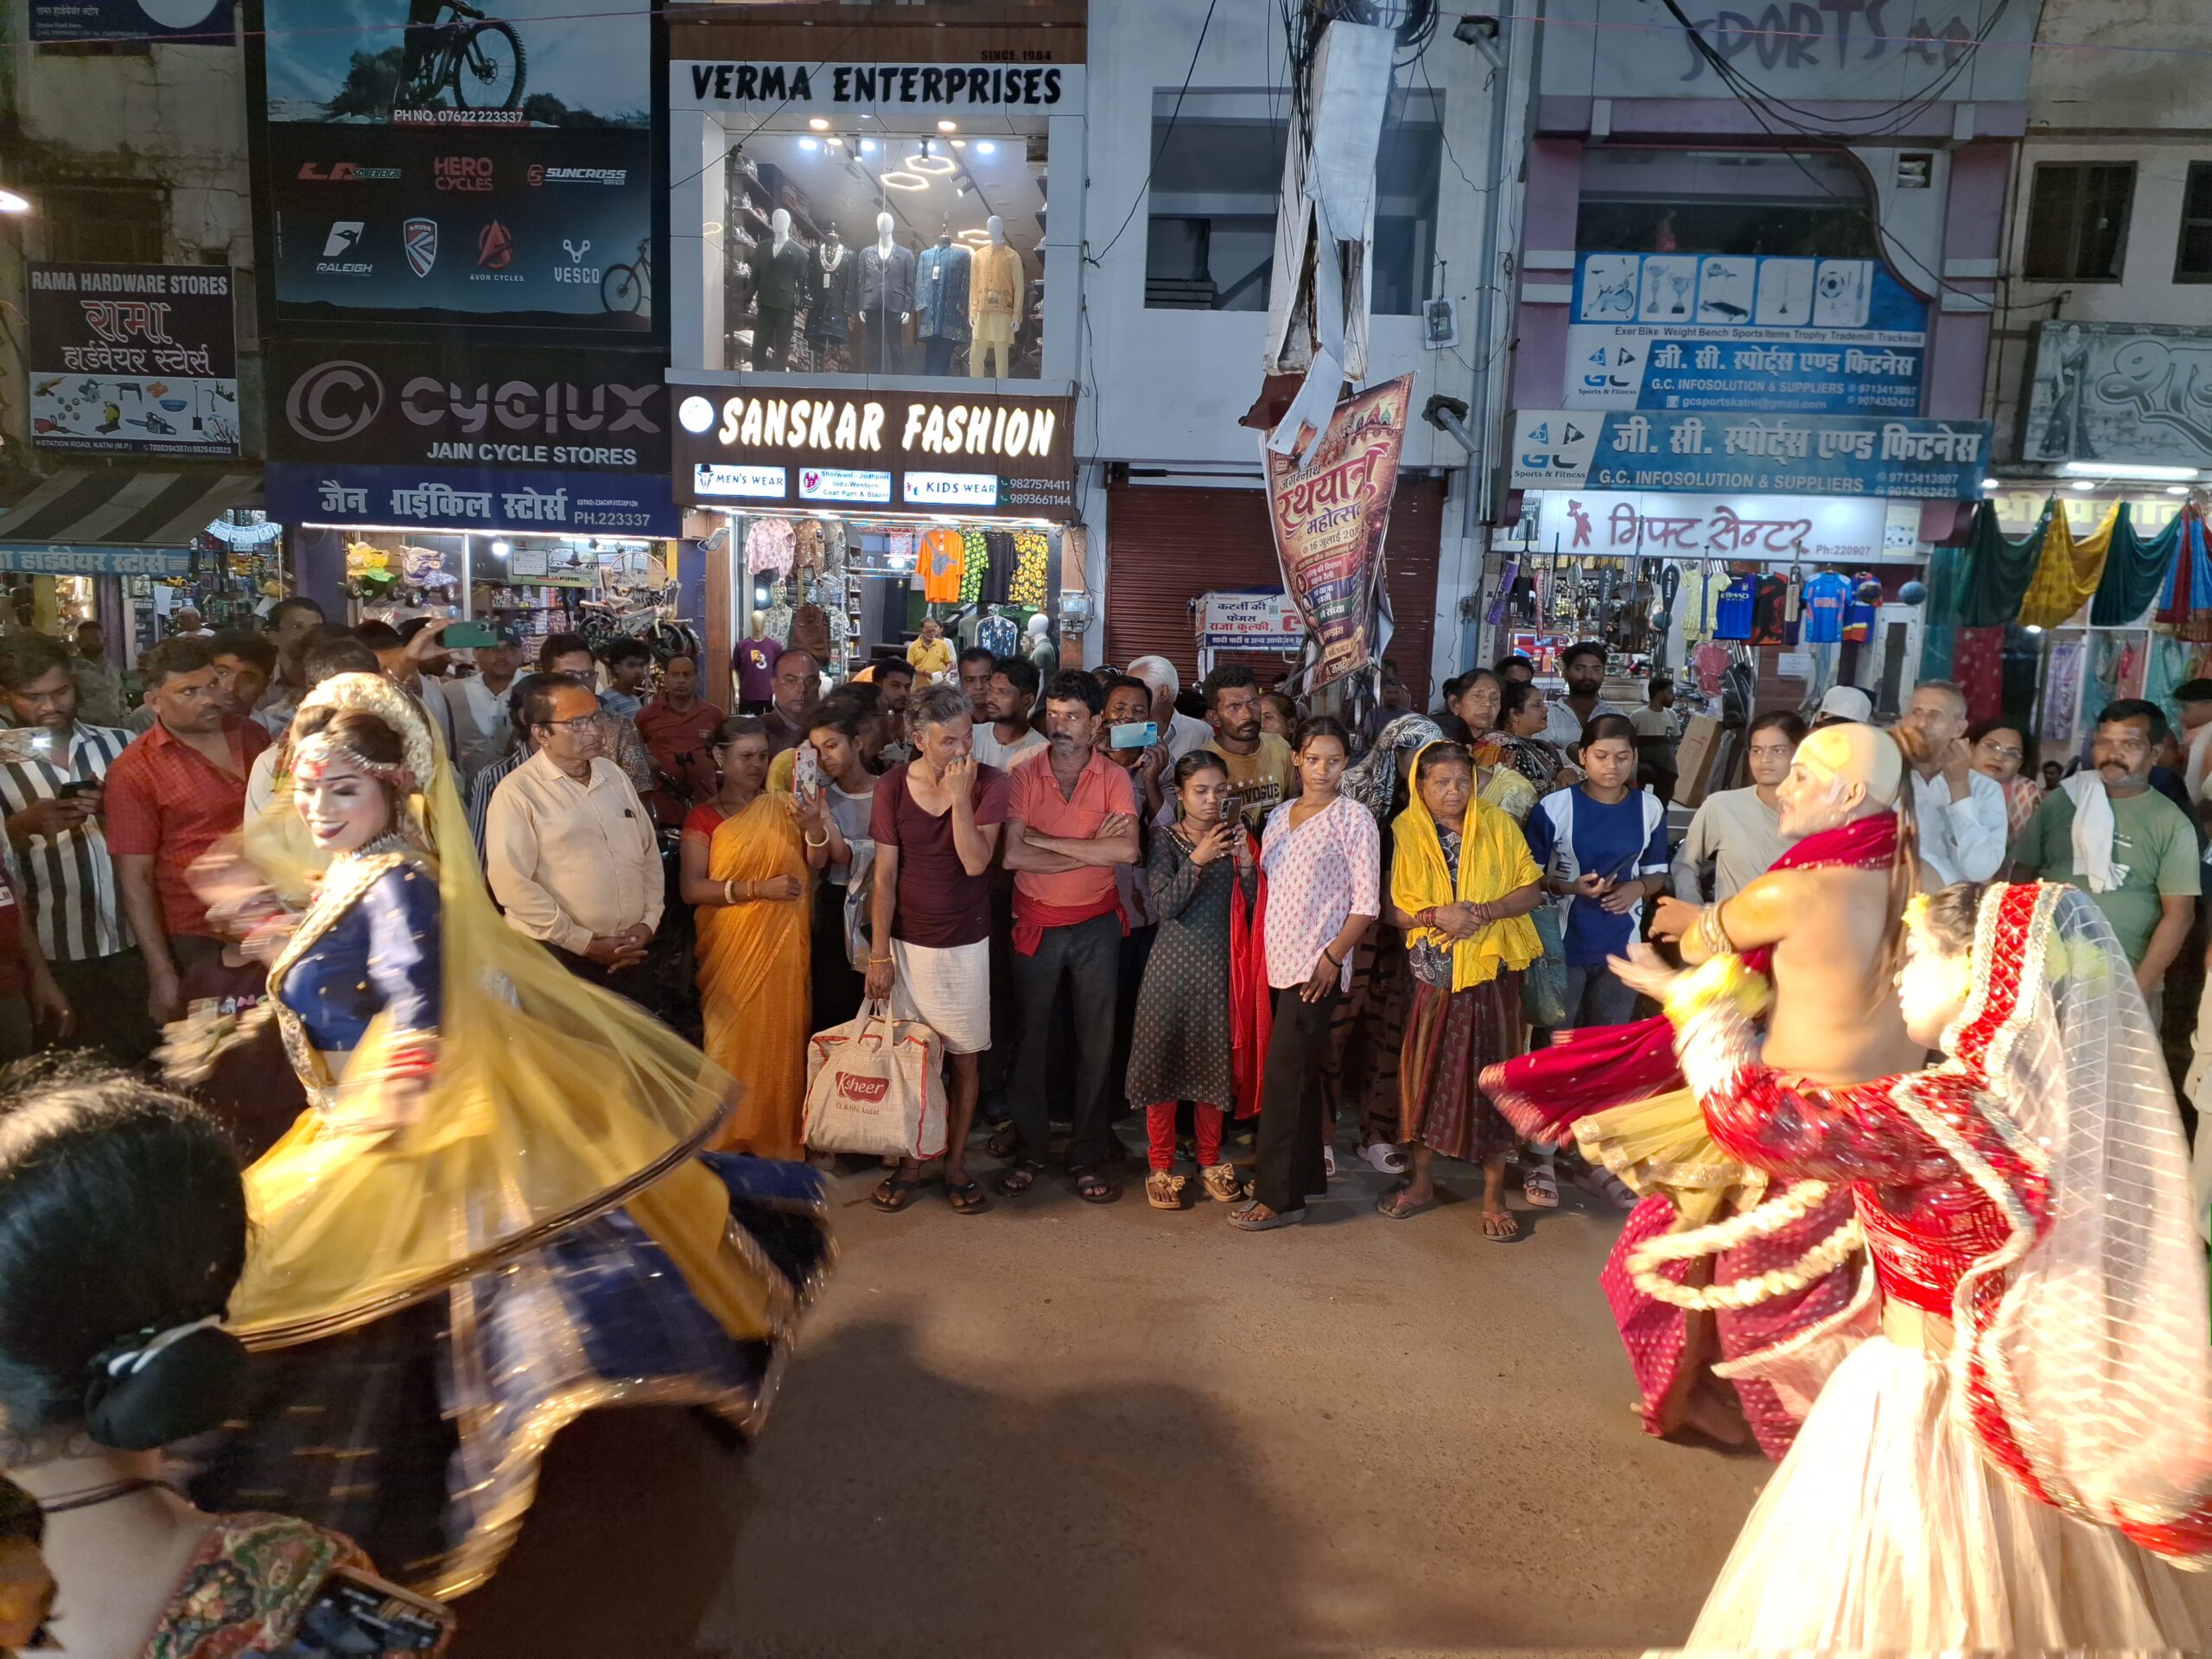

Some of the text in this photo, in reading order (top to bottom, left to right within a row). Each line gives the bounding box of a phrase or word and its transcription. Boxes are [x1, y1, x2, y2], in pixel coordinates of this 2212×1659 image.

[1681, 0, 1888, 81] SPORTS
[691, 64, 1061, 105] VERMA ENTERPRISES
[438, 110, 476, 122] 07622
[478, 111, 524, 123] 223337
[353, 168, 402, 180] SOVEREIGN
[435, 156, 494, 176] HERO
[545, 167, 627, 179] SUNCROSS
[435, 176, 494, 191] CYCLES
[316, 263, 372, 272] RALEIGH
[554, 267, 600, 284] VESCO
[32, 271, 227, 295] RAMA HARDWARE STORES
[80, 300, 174, 344] रामा
[1615, 327, 1636, 335] Exer
[1638, 327, 1659, 336] Bike
[1663, 327, 1696, 338] Weight
[1699, 328, 1728, 337] Bench
[1732, 328, 1763, 339] Sports
[1764, 330, 1790, 339] Items
[1795, 331, 1827, 342] Trophy
[61, 340, 214, 375] हार्डवेयर स्टोर्स
[1655, 344, 1688, 370] जी.
[1694, 344, 1726, 370] सी.
[1800, 353, 1841, 372] एण्ड
[1844, 348, 1916, 377] फिटनेस
[1579, 387, 1600, 396] Sports
[1651, 378, 1845, 395] G.C. INFOSOLUTION & SUPPLIERS
[718, 397, 1056, 457] SANSKAR FASHION
[1612, 410, 1658, 454] जी.
[1669, 413, 1712, 455] सी.
[1817, 429, 1878, 461] एण्ड
[1880, 423, 1982, 463] फिटनेस
[427, 442, 638, 466] JAIN CYCLE STORES
[715, 473, 784, 486] MEN'S WEAR
[1515, 470, 1542, 479] Sports
[1554, 470, 1586, 479] Fitness
[1599, 469, 1865, 493] G.C. INFOSOLUTION & SUPPLIERS
[926, 481, 995, 493] KIDS WEAR
[1009, 479, 1071, 490] 9827574411
[319, 480, 367, 513] जैन
[501, 486, 569, 521] स्टोर्स
[1009, 493, 1071, 505] 9893661144
[574, 512, 651, 527] PH.223337
[1609, 502, 1813, 555] गिफ्ट सेन्टर
[1815, 543, 1872, 557] Ph:220907
[20, 545, 109, 571] हार्डवेयर
[111, 548, 168, 574] स्टोर्स
[1251, 601, 1266, 611] की
[1227, 613, 1256, 622] फेमस
[837, 1072, 884, 1096] Ksheer
